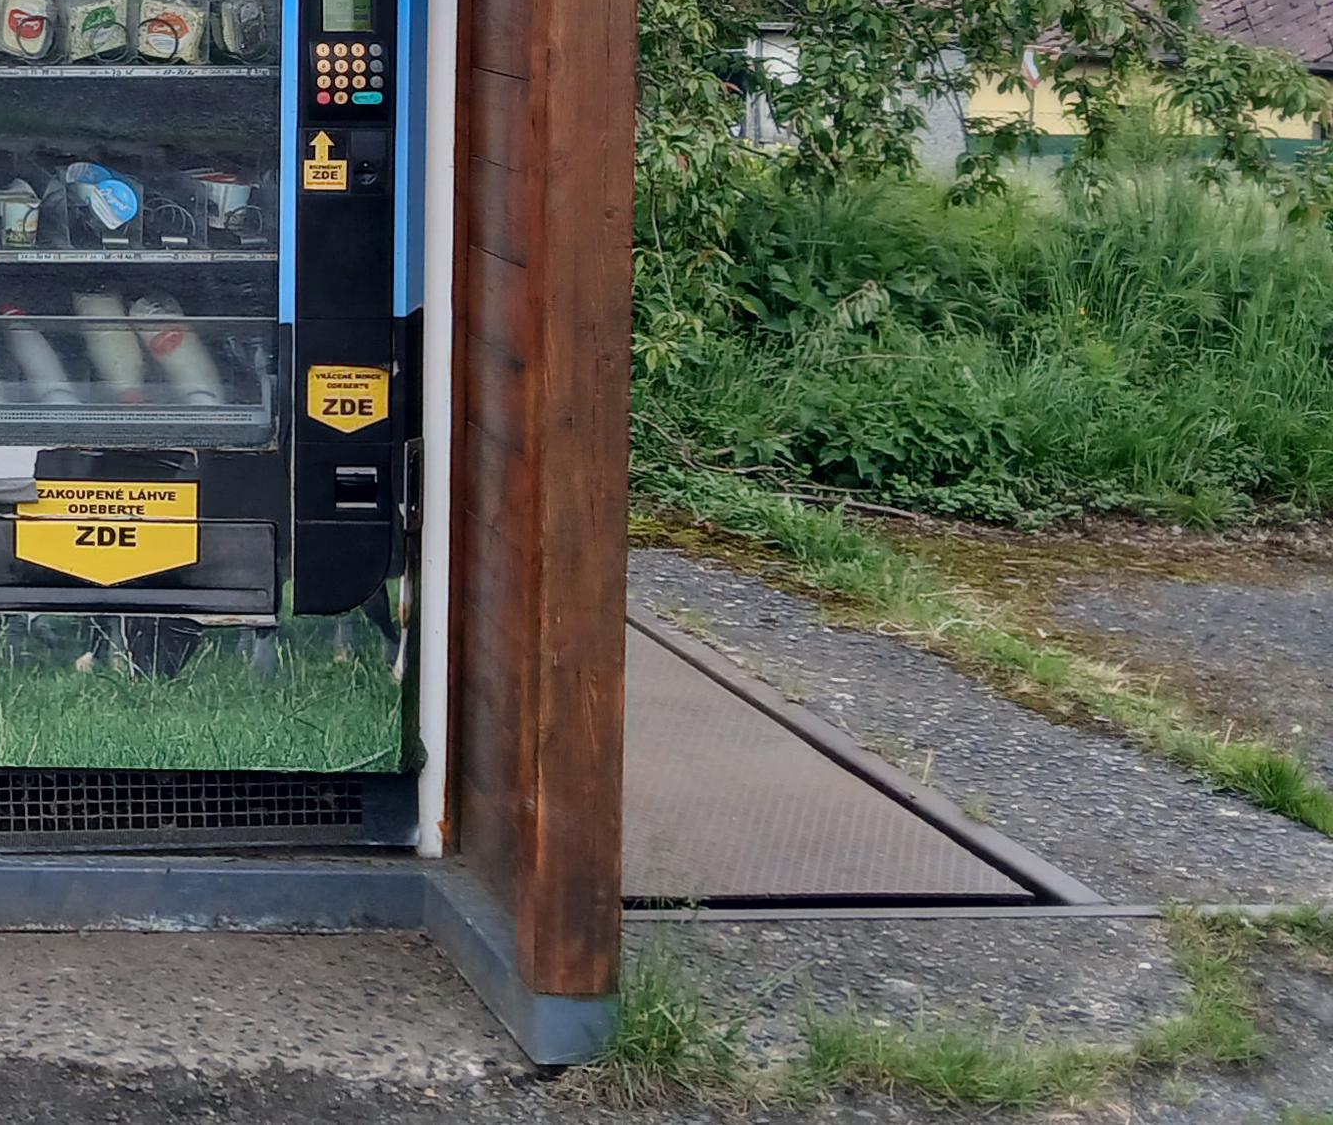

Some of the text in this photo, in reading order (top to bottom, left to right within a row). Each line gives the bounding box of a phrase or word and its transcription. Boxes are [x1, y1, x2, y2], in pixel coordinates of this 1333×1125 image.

[312, 171, 339, 179] ZDE
[322, 398, 373, 415] ZDE
[37, 488, 177, 501] ZAKOUPENÉ LÁHVE
[68, 504, 145, 515] ODEBERTE
[75, 526, 137, 547] ZDE
